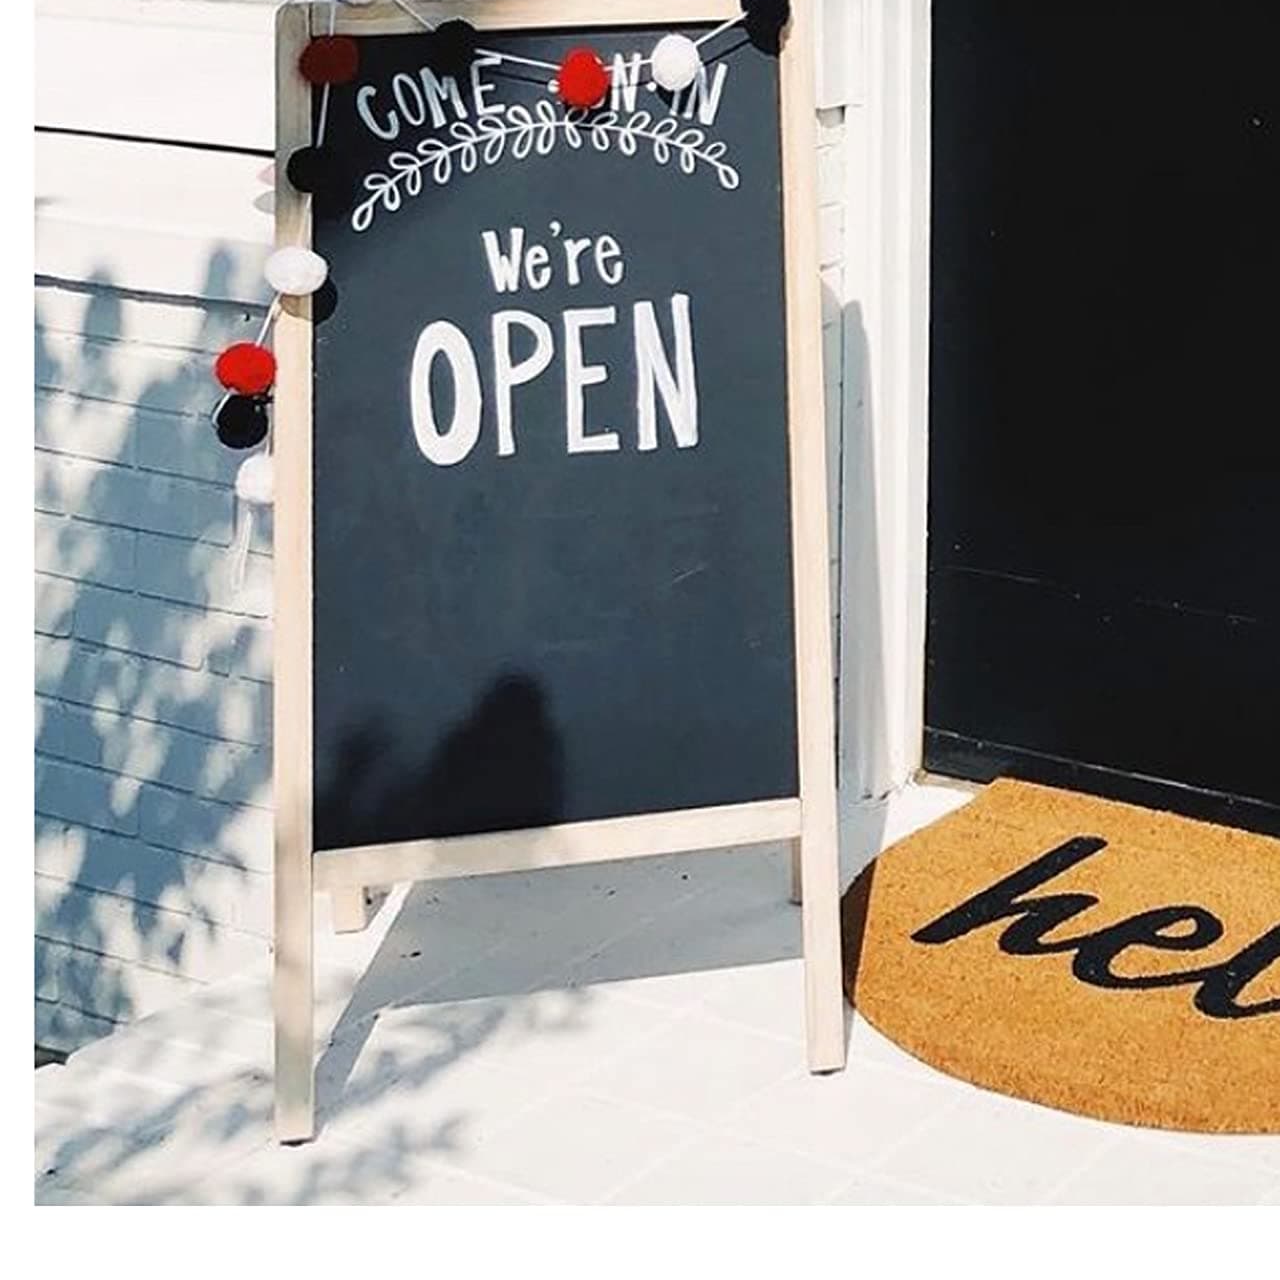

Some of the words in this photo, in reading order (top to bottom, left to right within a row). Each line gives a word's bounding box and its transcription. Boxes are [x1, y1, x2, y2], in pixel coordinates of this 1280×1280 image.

[356, 57, 506, 141] COME
[562, 52, 642, 113] N
[482, 222, 625, 293] We're
[409, 293, 699, 467] OPEN
